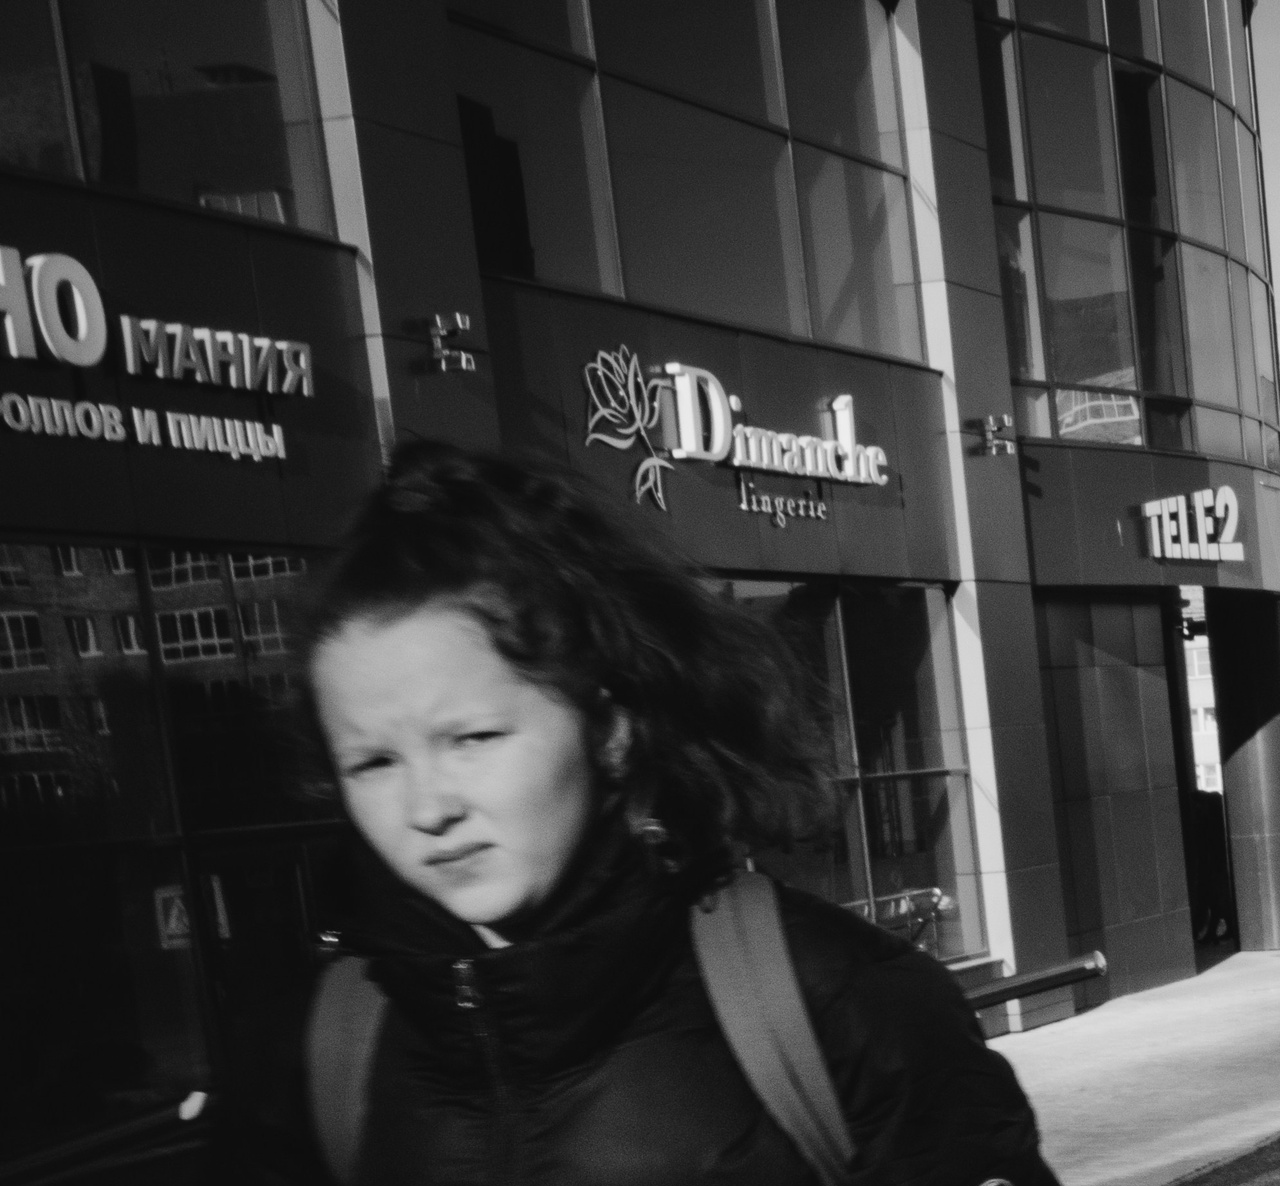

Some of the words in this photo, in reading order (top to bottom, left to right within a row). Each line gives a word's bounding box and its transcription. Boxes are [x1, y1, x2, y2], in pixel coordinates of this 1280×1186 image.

[120, 314, 314, 397] МАНИЯ
[0, 392, 126, 442] ОЛЛОВ
[132, 406, 162, 446] И
[166, 411, 286, 461] ПИЦЦЫ
[665, 362, 888, 485] Dimanche
[740, 475, 827, 527] lingerie
[1143, 485, 1244, 561] TELE2
